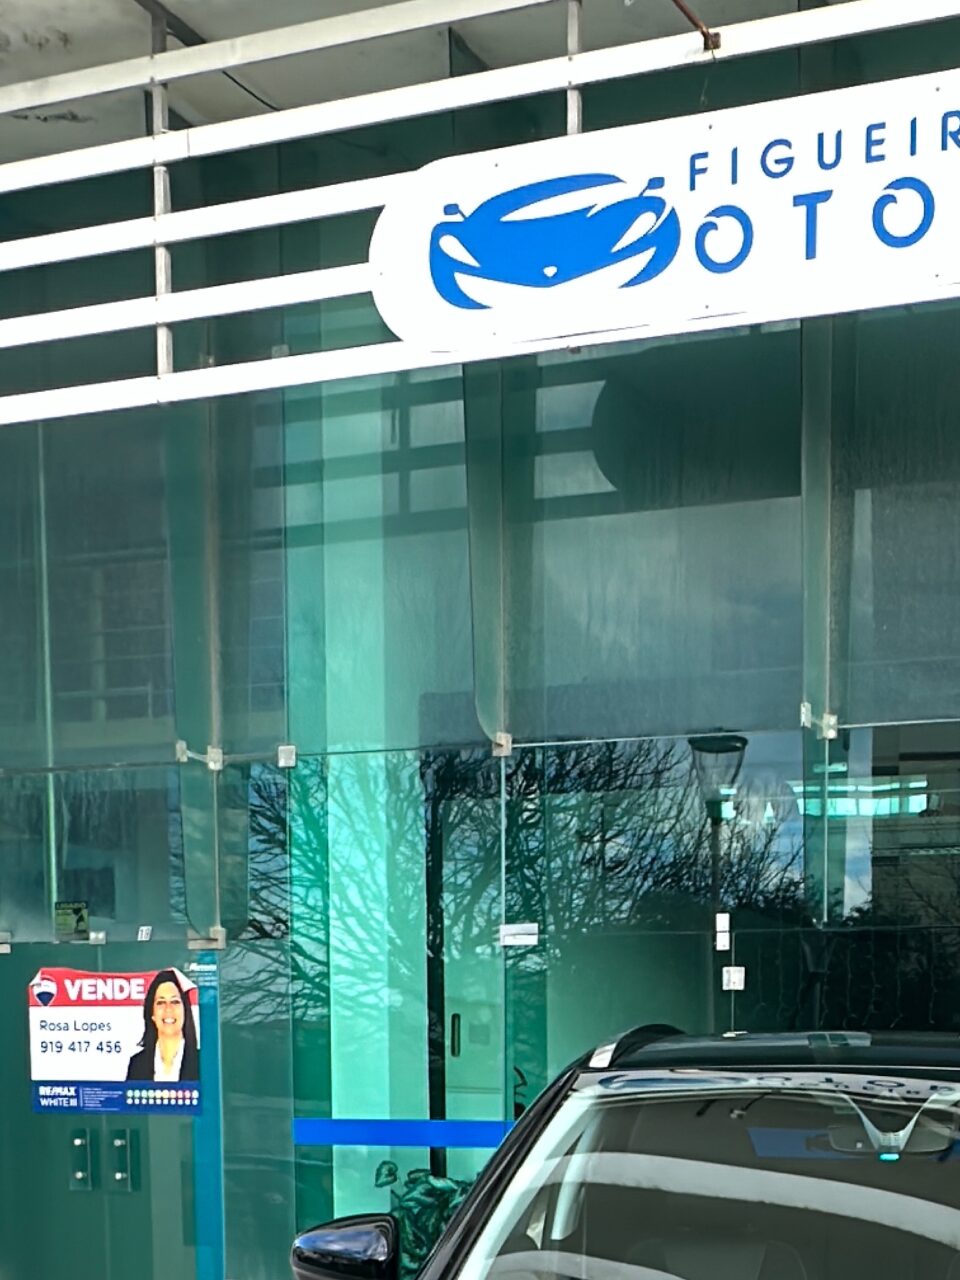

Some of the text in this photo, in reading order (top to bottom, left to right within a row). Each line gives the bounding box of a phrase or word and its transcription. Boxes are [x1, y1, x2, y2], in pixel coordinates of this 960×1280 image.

[63, 978, 145, 1001] VENDE
[40, 1020, 112, 1033] Rosa Lopes
[40, 1041, 122, 1053] 919 417 456
[40, 1097, 69, 1107] WHITE
